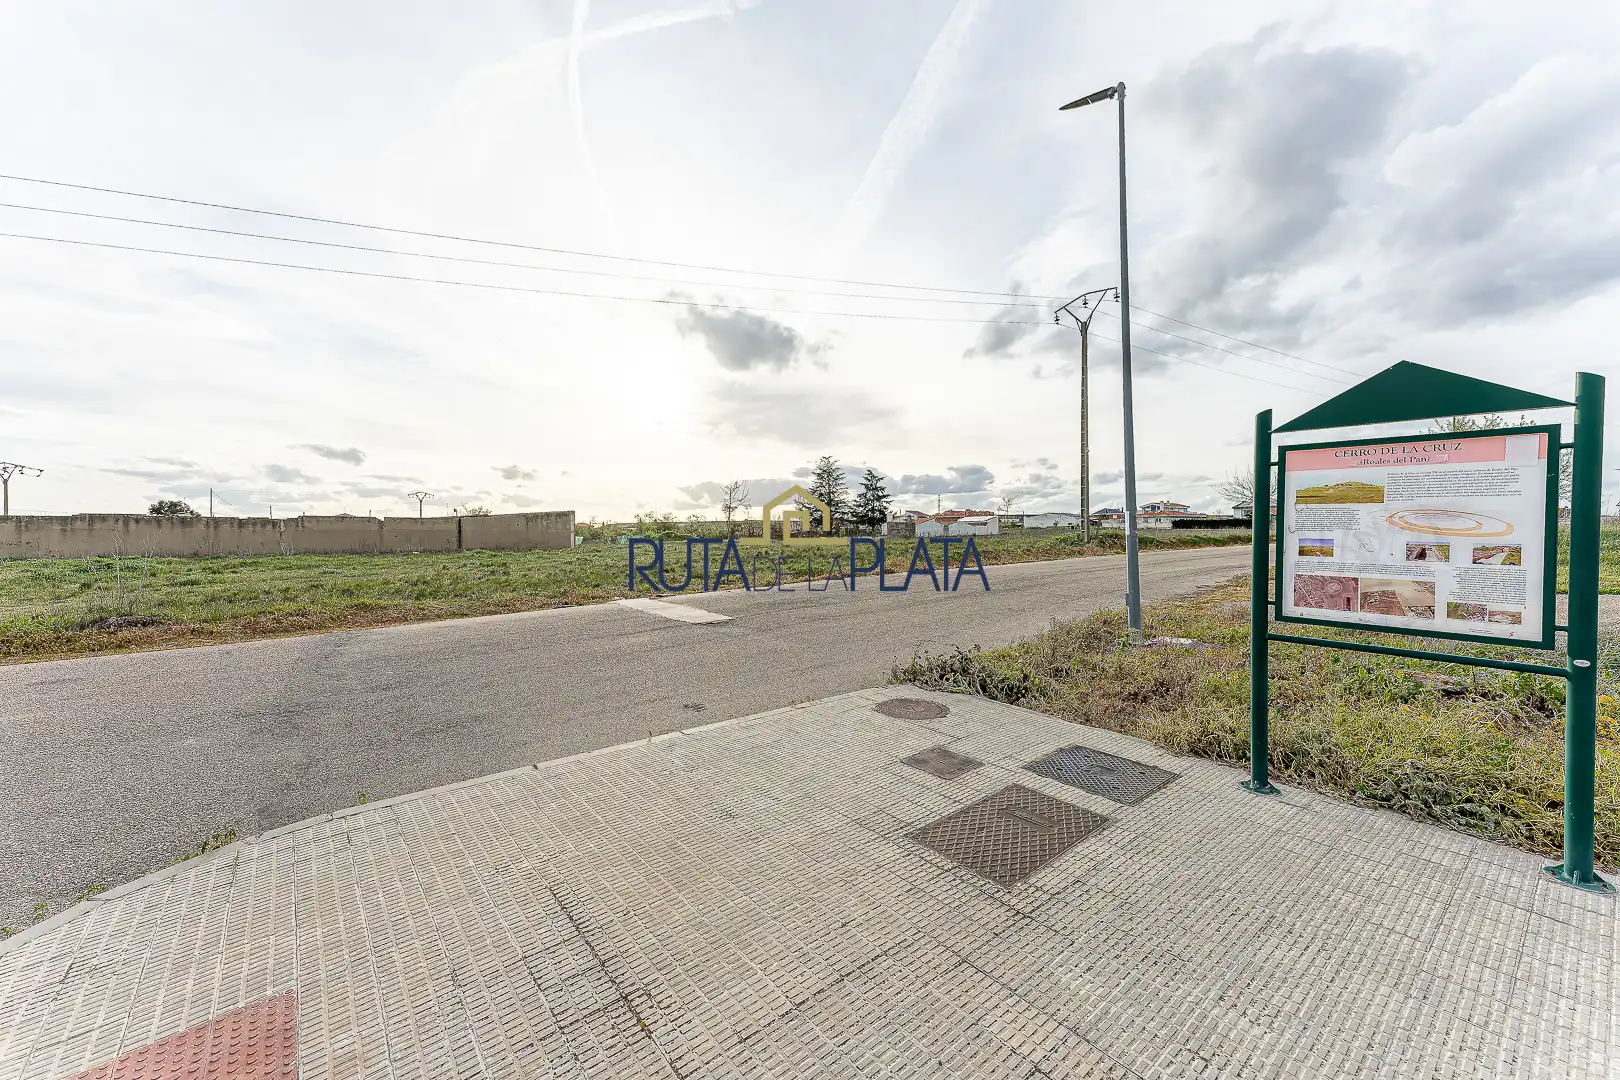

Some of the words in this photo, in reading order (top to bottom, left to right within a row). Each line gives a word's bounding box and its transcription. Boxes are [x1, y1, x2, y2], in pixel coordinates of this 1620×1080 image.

[1334, 447, 1377, 458] CERRO
[1381, 446, 1398, 455] DE
[1402, 445, 1418, 454] LA
[1422, 442, 1462, 453] CRUZ
[1360, 458, 1390, 466] (Roales
[1393, 456, 1407, 464] del
[1410, 455, 1430, 463] Pan)
